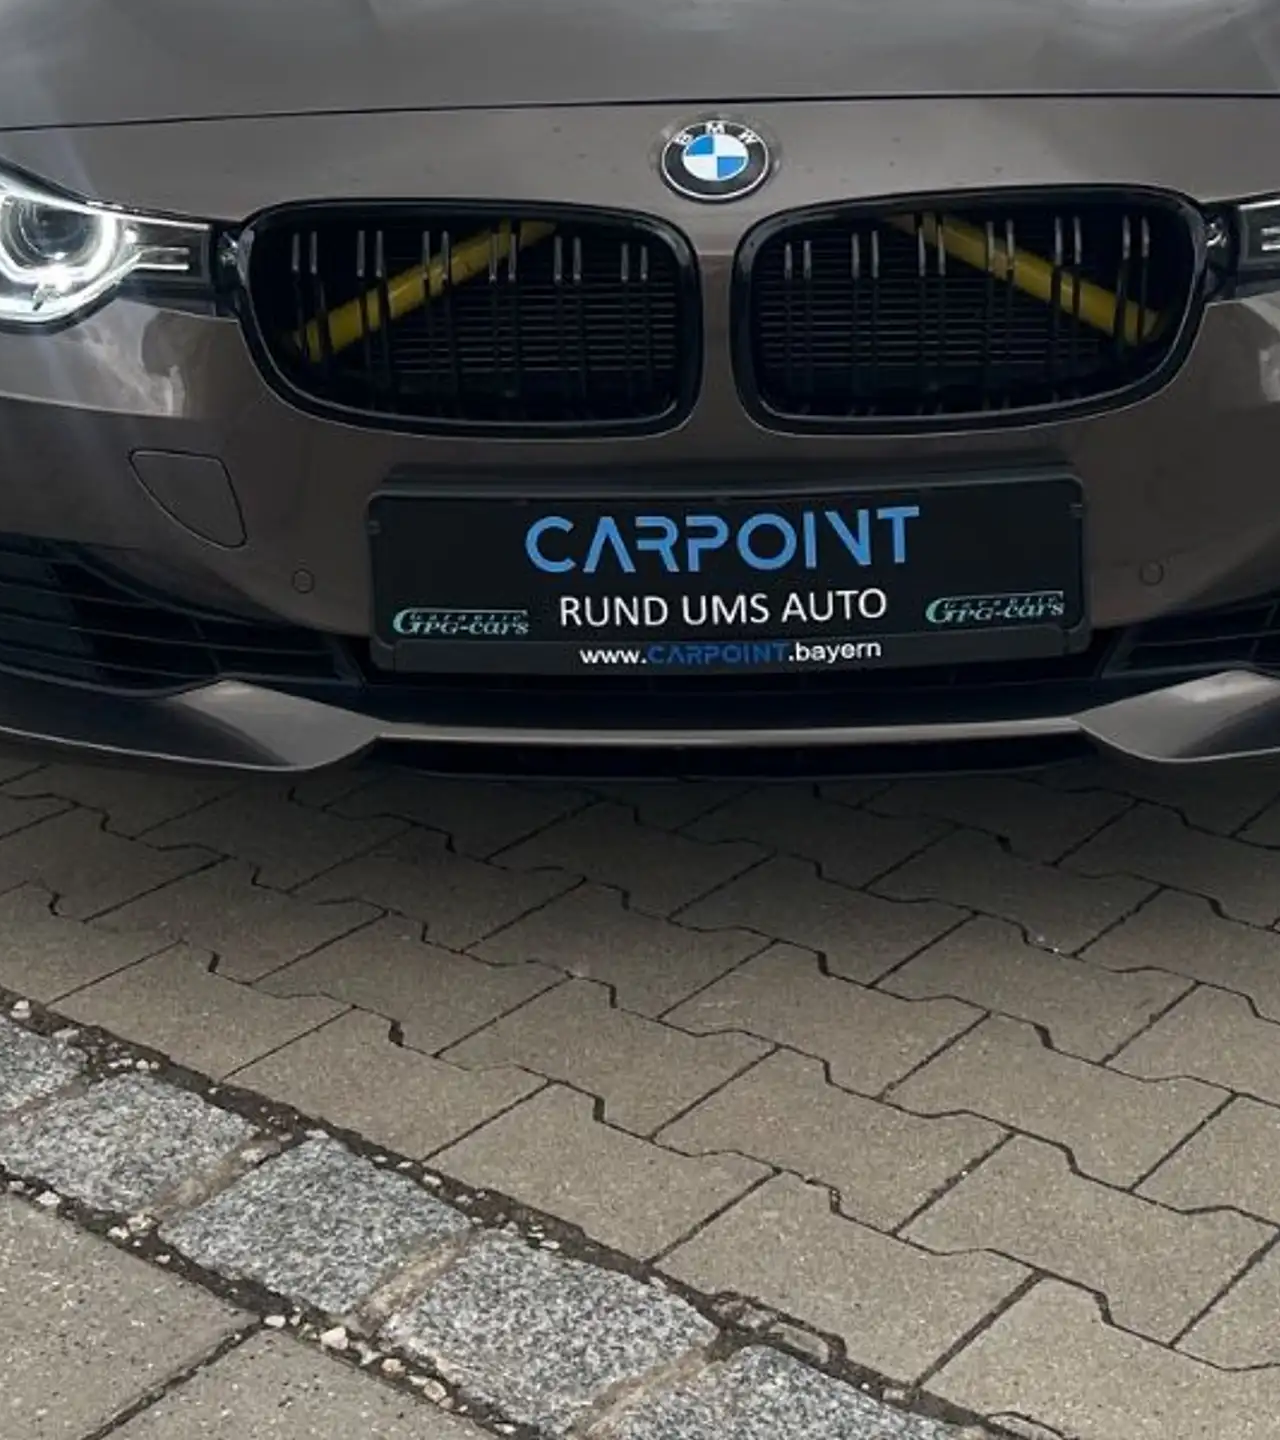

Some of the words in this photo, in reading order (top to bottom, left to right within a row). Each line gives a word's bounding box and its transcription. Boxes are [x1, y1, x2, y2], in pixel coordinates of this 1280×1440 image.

[674, 120, 761, 145] BMW
[525, 506, 919, 574] CARPOINT
[560, 596, 669, 627] RUND
[682, 593, 770, 626] UMS
[781, 588, 888, 623] AUTO
[579, 641, 882, 665] www.CARPOINT.bayern
